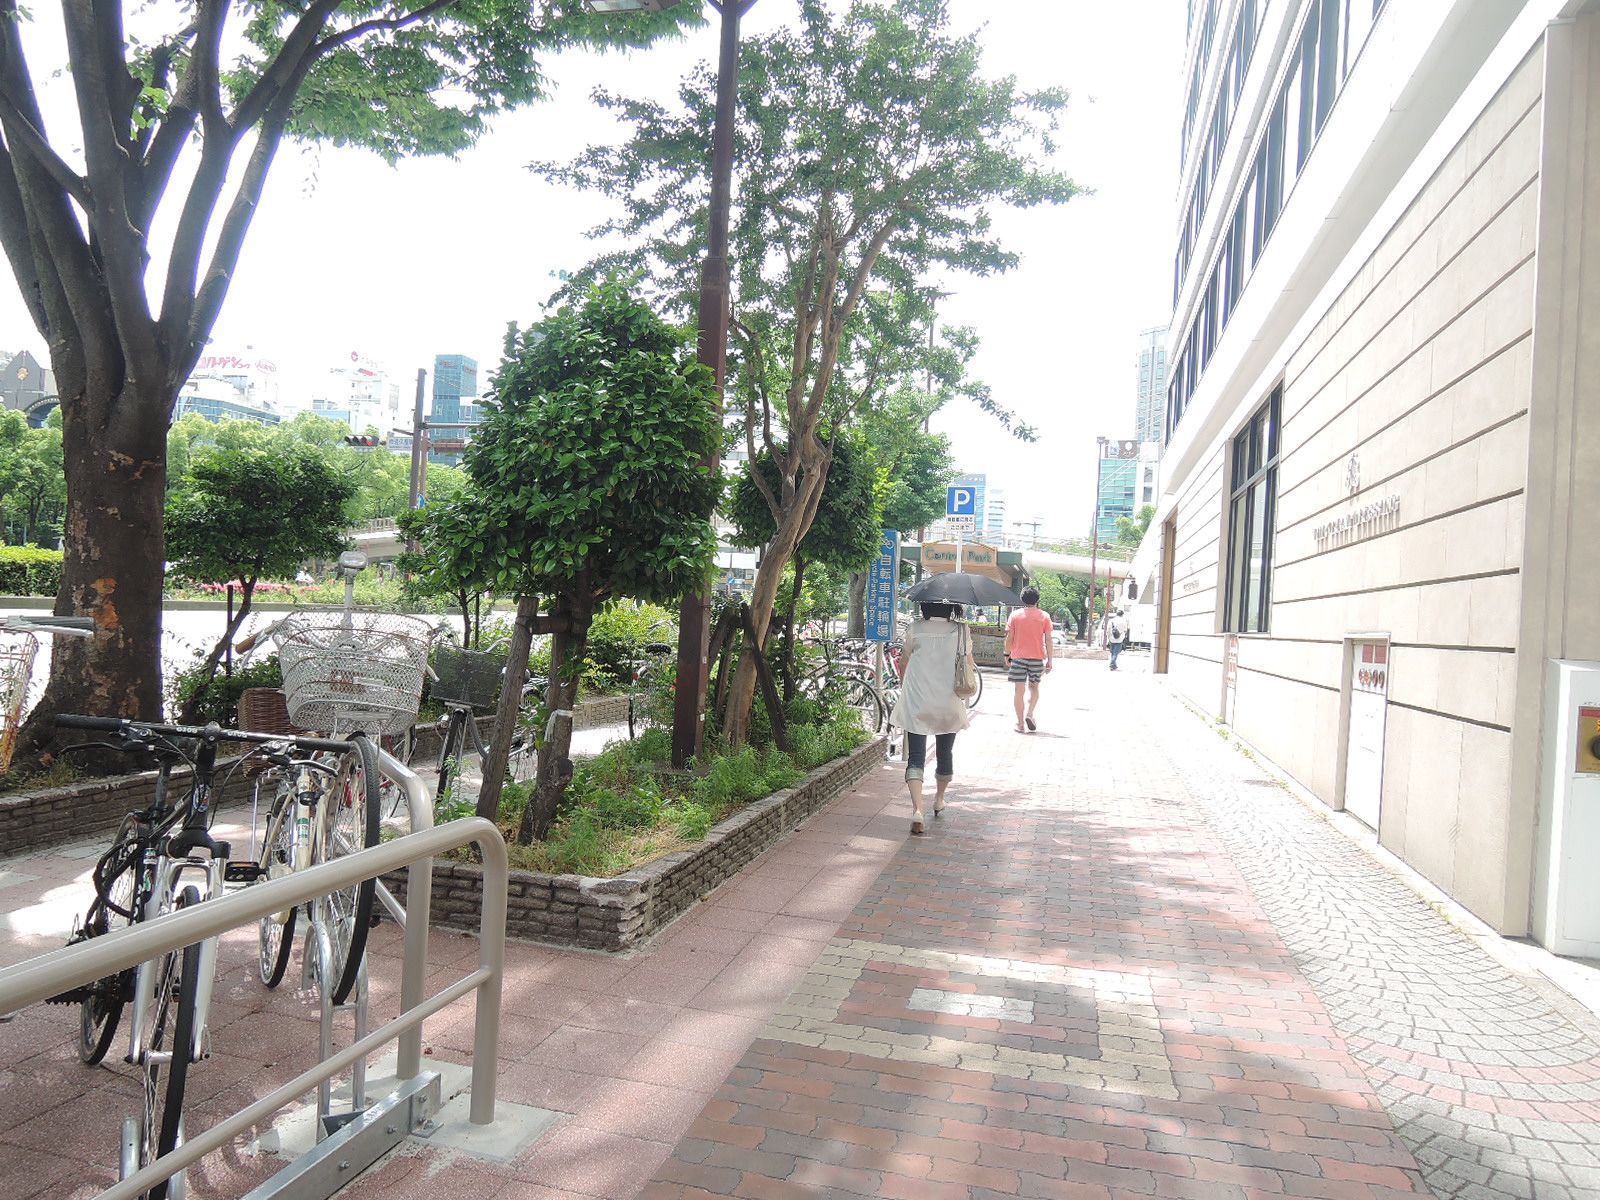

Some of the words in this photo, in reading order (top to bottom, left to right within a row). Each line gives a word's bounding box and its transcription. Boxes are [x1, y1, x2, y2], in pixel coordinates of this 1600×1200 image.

[954, 490, 970, 512] P
[925, 548, 965, 562] Centrl
[968, 550, 992, 562] Park
[876, 554, 892, 637] 自転車駐輪場
